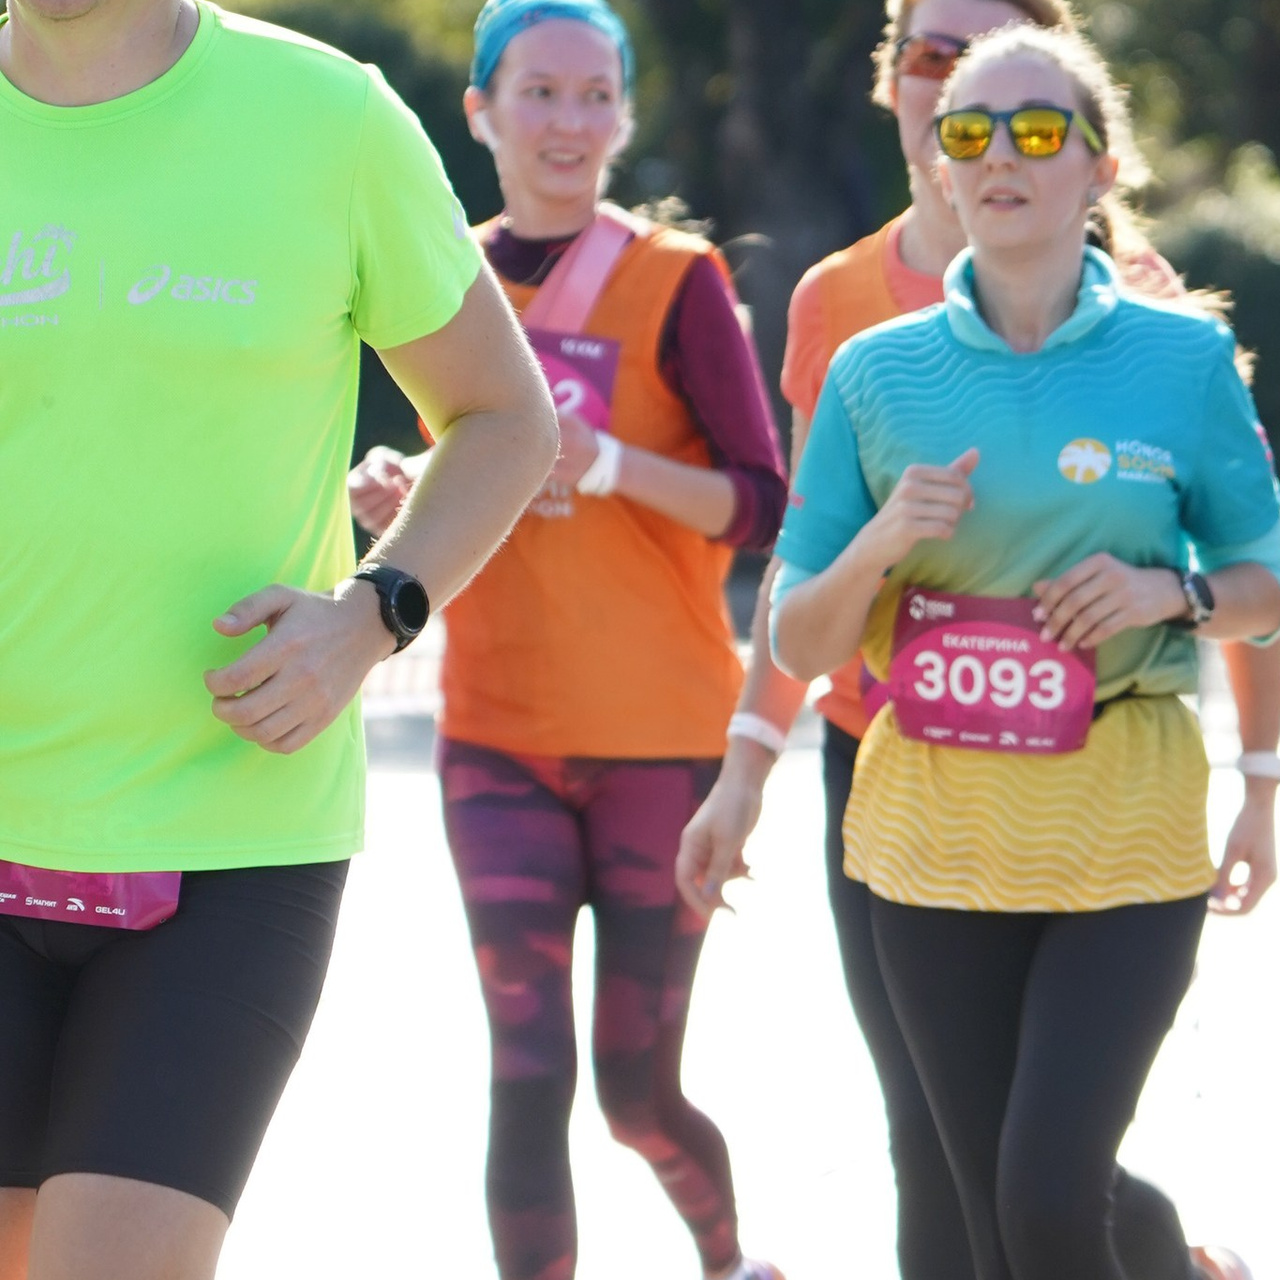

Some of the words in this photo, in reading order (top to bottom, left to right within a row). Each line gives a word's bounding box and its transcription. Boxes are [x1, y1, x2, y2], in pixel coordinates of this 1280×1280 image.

[942, 632, 1030, 653] ЕКАТЕРИНА
[913, 650, 1066, 710] 3093
[95, 905, 126, 916] GEL4U
